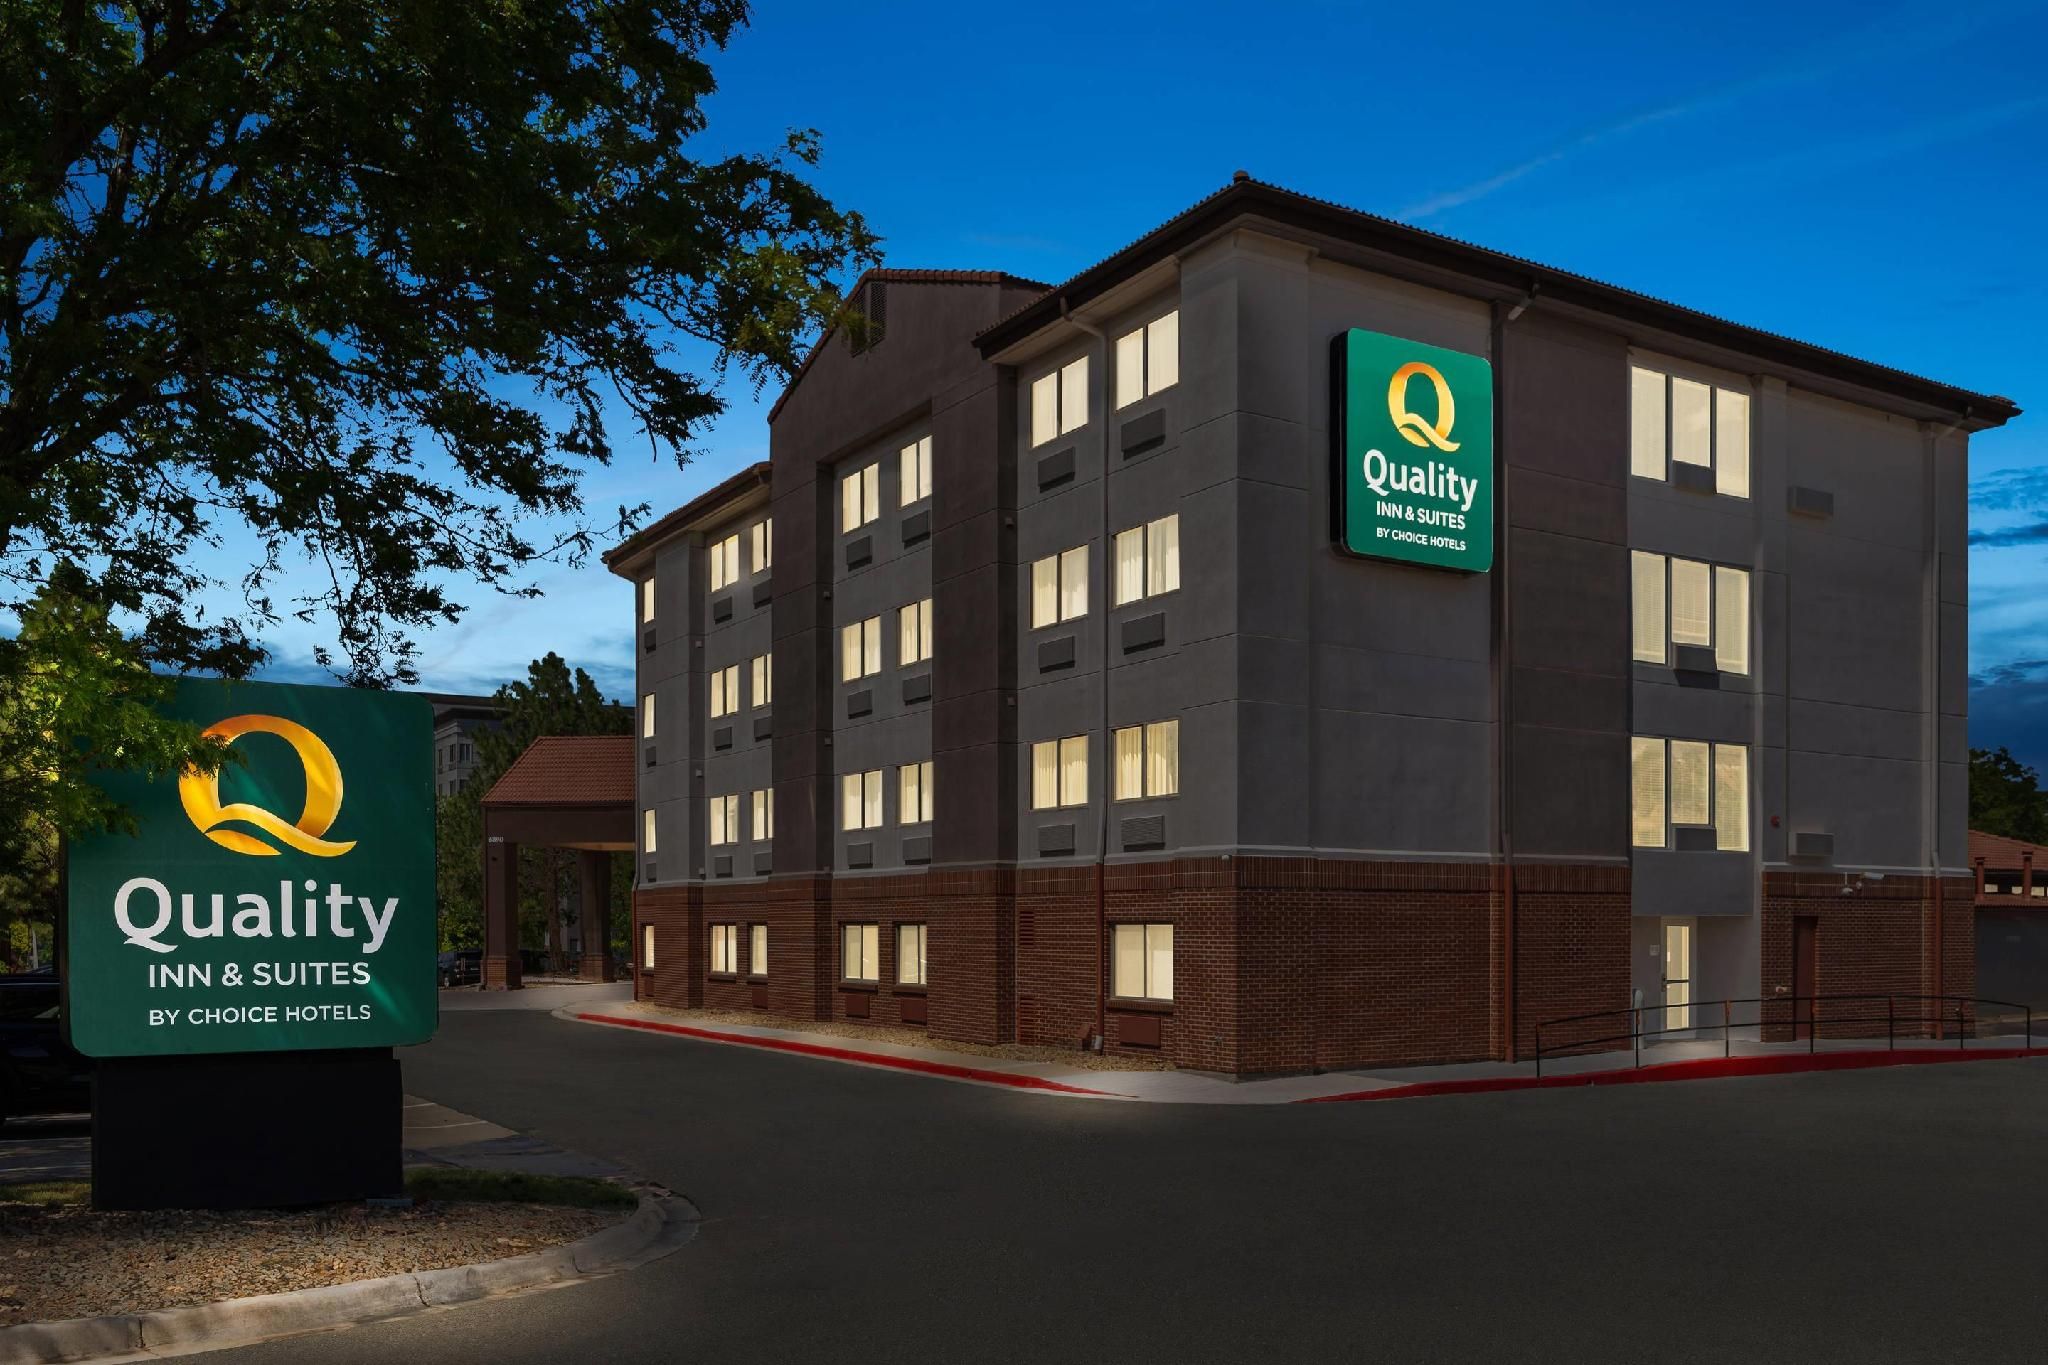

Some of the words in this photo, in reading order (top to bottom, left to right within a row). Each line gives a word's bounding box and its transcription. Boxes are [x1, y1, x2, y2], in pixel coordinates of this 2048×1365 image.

[1387, 361, 1461, 452] Q
[1363, 448, 1478, 512] Quality
[1376, 500, 1403, 519] INN
[1404, 506, 1415, 521] &
[1417, 507, 1466, 530] SUITES
[1376, 527, 1390, 538] BY
[1391, 529, 1428, 545] CHOICE
[1430, 536, 1466, 551] HOTELS
[178, 713, 358, 857] Q
[114, 877, 399, 954] Quality
[149, 962, 211, 988] INN
[221, 962, 244, 987] &
[252, 961, 371, 986] SUITES
[149, 1008, 181, 1026] BY
[187, 1006, 278, 1025] CHOICE
[285, 1004, 371, 1022] HOTELS
